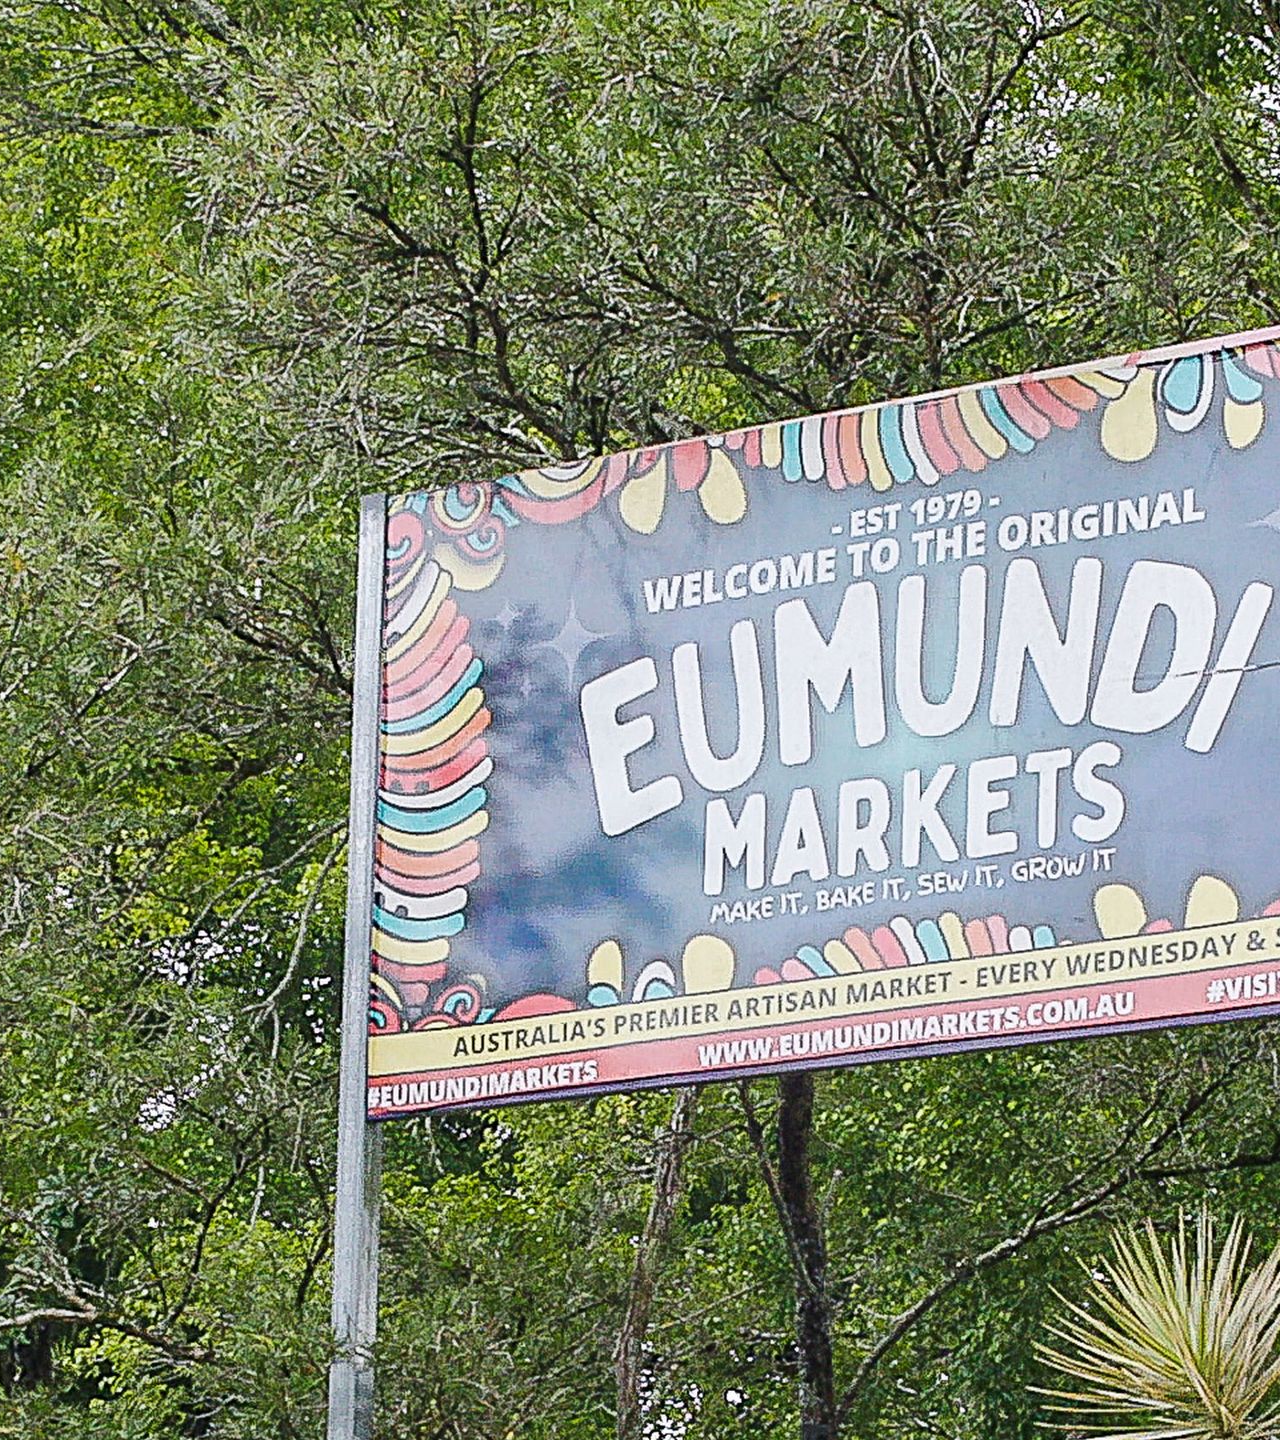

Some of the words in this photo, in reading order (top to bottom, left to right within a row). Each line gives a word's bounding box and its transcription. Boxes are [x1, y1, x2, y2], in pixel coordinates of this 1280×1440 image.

[642, 548, 837, 614] WELCOME
[847, 537, 900, 577] TO
[912, 520, 986, 566] THE
[997, 488, 1206, 551] ORIGINAL
[850, 503, 901, 537] EST
[910, 489, 980, 527] 1979
[580, 556, 1274, 837] EUMUNDI
[702, 740, 1125, 897] MARKETS
[709, 895, 775, 925] MAKE
[779, 891, 809, 915] IT,
[816, 881, 877, 912] BAKE
[882, 877, 911, 903] IT,
[916, 868, 970, 899] SEW
[974, 863, 1005, 889] IT,
[1011, 853, 1086, 884] GROW
[1091, 847, 1117, 872] IT
[368, 1060, 598, 1108] #EUMUNDIMARKETS
[697, 991, 1135, 1067] WWW.EUMUNDIMARKETS.COM.AU
[452, 1018, 607, 1058] AUSTRALIA'S
[613, 1003, 719, 1038] PREMIER
[727, 986, 837, 1023] ARTISAN
[845, 969, 952, 1006] MARKET
[976, 957, 1057, 990] EVERY
[1065, 934, 1239, 977] WEDNESDAY
[1246, 930, 1266, 951] &
